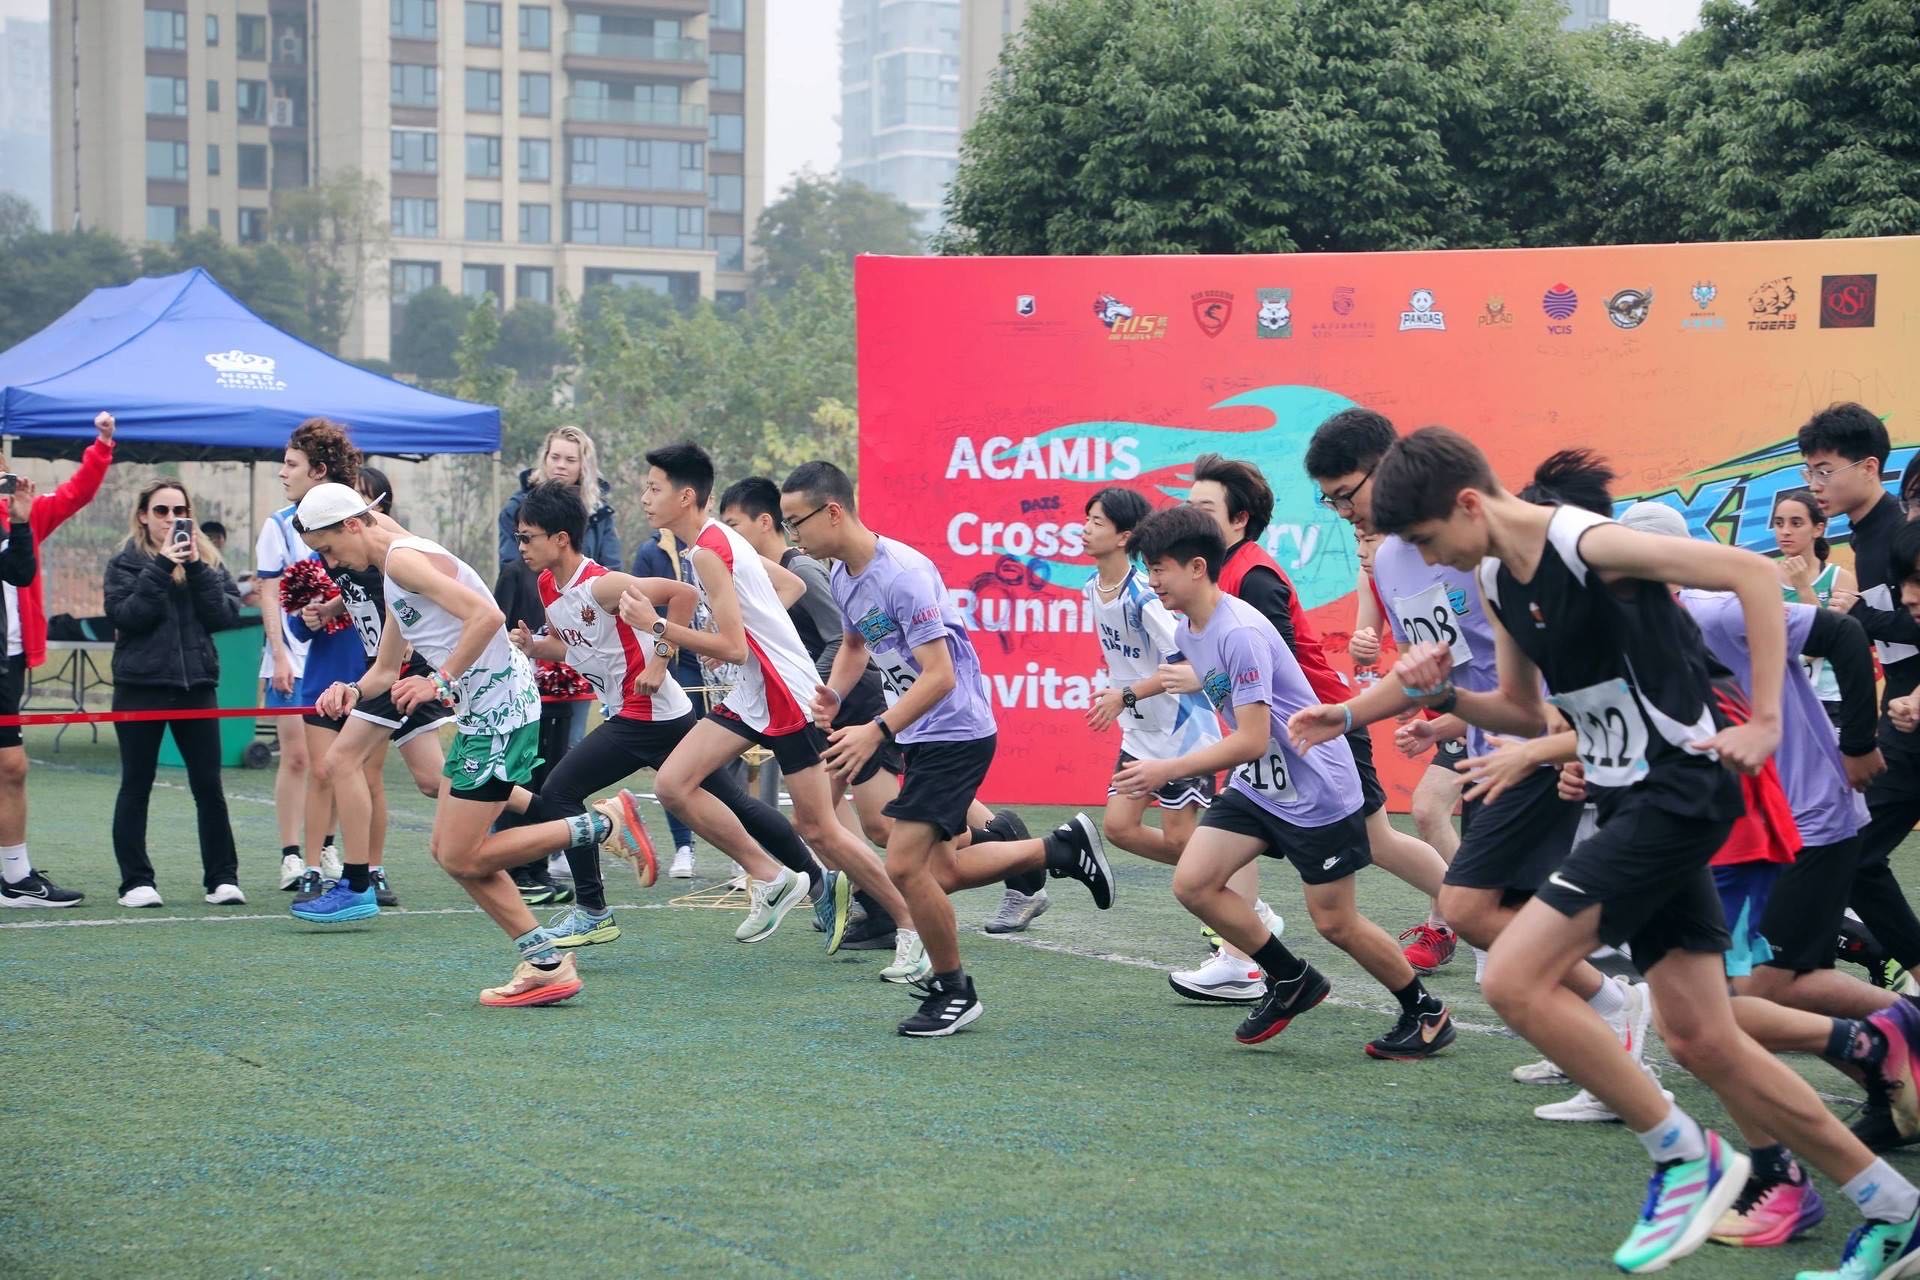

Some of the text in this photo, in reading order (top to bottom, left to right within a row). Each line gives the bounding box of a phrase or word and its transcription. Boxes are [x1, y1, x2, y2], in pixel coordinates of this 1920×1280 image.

[1829, 285, 1868, 316] QSI
[1111, 315, 1158, 334] HIS
[1403, 312, 1443, 326] PANDAS
[1747, 320, 1797, 331] TIGERS
[1547, 325, 1573, 336] YCIS
[215, 377, 288, 388] ANGLIA
[220, 372, 275, 381] NORD
[945, 436, 1142, 481] ACAMIS
[946, 512, 1086, 557] Cross
[946, 586, 1094, 634] Runni
